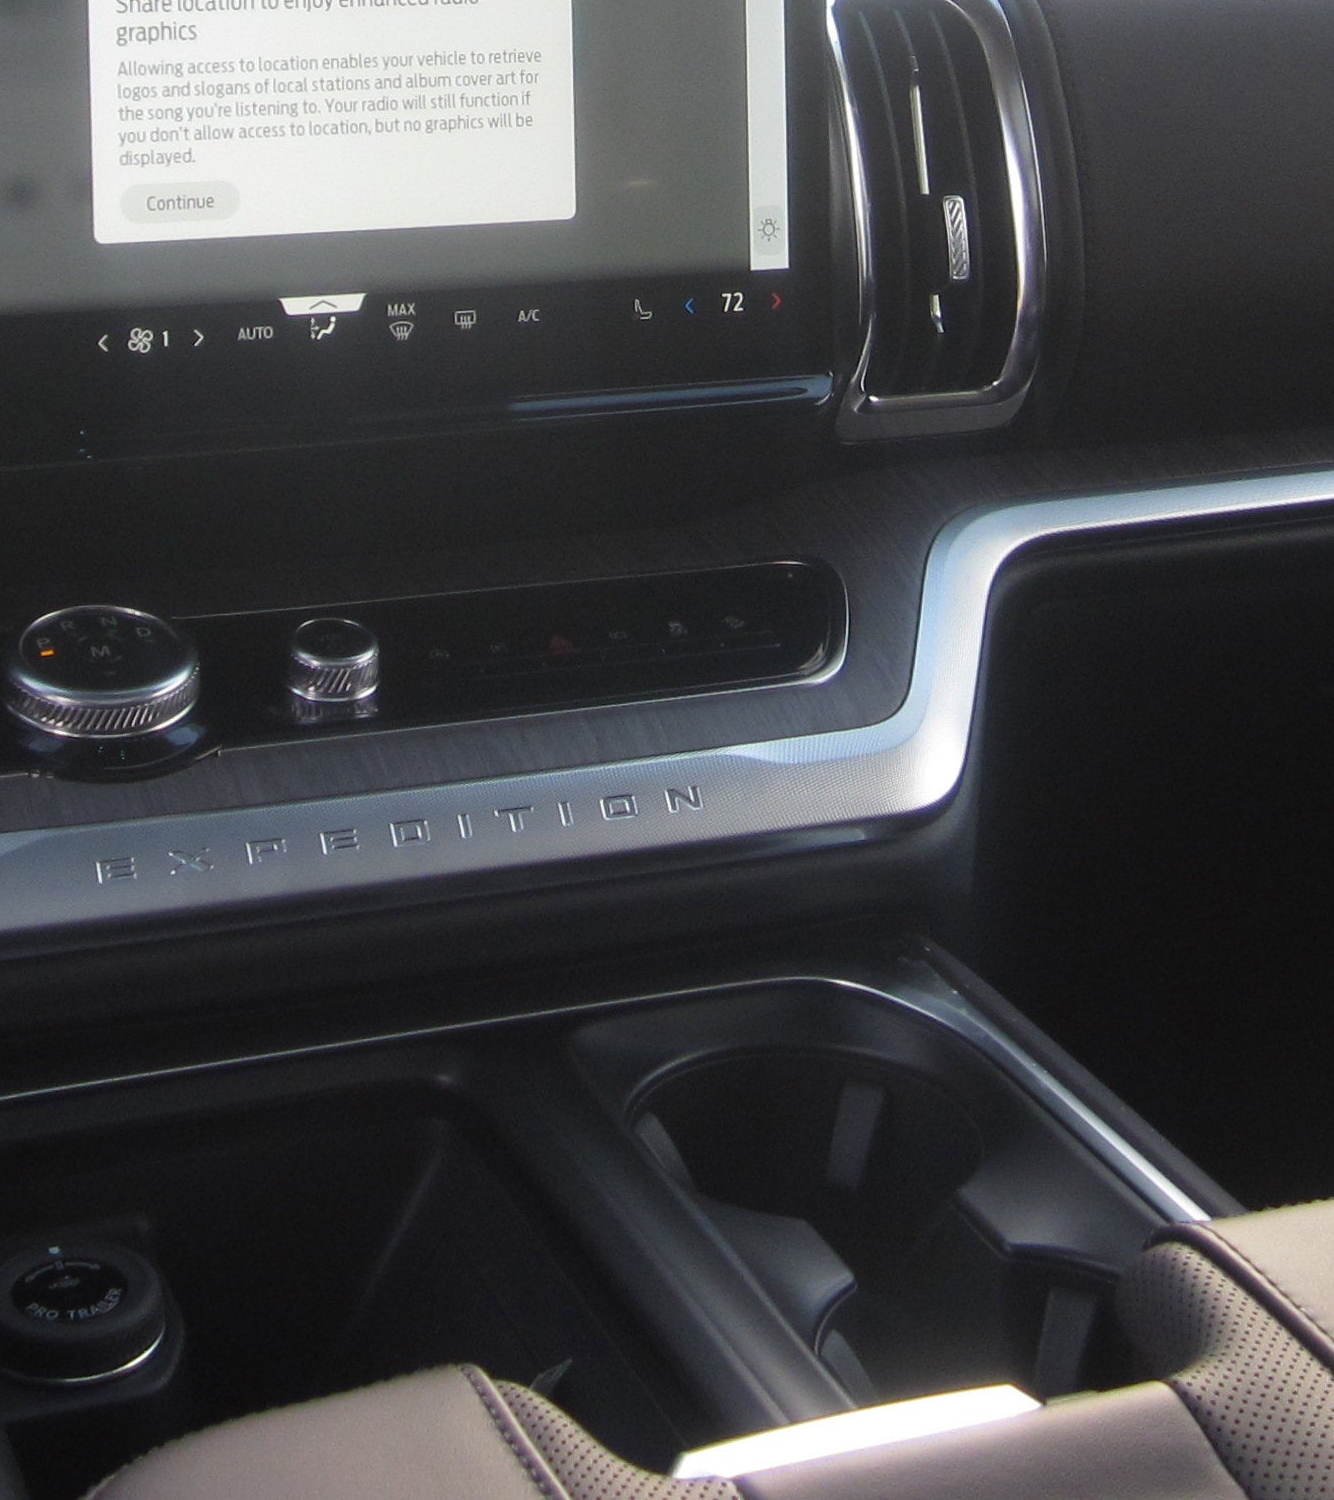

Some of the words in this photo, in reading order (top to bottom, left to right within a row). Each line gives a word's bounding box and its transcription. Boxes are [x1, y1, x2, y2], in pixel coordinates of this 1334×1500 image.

[116, 21, 197, 46] graphics
[117, 60, 183, 77] Allowing
[187, 60, 235, 75] access
[239, 58, 255, 72] to
[258, 56, 318, 72] location
[322, 53, 378, 69] enables
[382, 55, 413, 70] your
[417, 50, 467, 67] vehicle
[470, 50, 485, 64] to
[488, 48, 542, 64] retrieve
[117, 83, 158, 101] logos
[161, 81, 191, 98] and
[194, 80, 250, 98] slogans
[254, 78, 270, 94] of
[272, 77, 308, 93] local
[311, 76, 370, 92] stations
[374, 73, 402, 89] and
[405, 73, 452, 89] album
[455, 74, 492, 87] cover
[496, 71, 516, 85] art
[519, 69, 539, 84] for
[118, 105, 144, 121] the
[147, 106, 183, 122] song
[187, 102, 232, 121] you're
[235, 101, 299, 117] listening
[303, 100, 321, 114] to.
[324, 98, 358, 113] Your
[361, 96, 398, 112] radio
[402, 94, 426, 110] will
[430, 93, 456, 109] still
[459, 91, 518, 108] function
[521, 90, 531, 105] if
[118, 130, 146, 147] you
[149, 126, 189, 142] don't
[193, 125, 234, 140] allow
[238, 123, 286, 139] access
[289, 122, 305, 137] to
[308, 119, 371, 136] location,
[374, 118, 400, 133] but
[404, 119, 421, 132] no
[425, 114, 484, 133] graphics
[487, 113, 512, 128] will
[515, 112, 533, 127] be
[119, 148, 196, 167] displayed.
[146, 193, 215, 212] Continue
[386, 302, 416, 317] MAX
[720, 291, 744, 313] 72
[516, 309, 540, 324] A/C
[237, 325, 274, 341] AUTO
[89, 644, 111, 658] M
[94, 785, 707, 885] EXPEDITION
[24, 1301, 59, 1320] PRO
[66, 1286, 124, 1321] TRAILER
